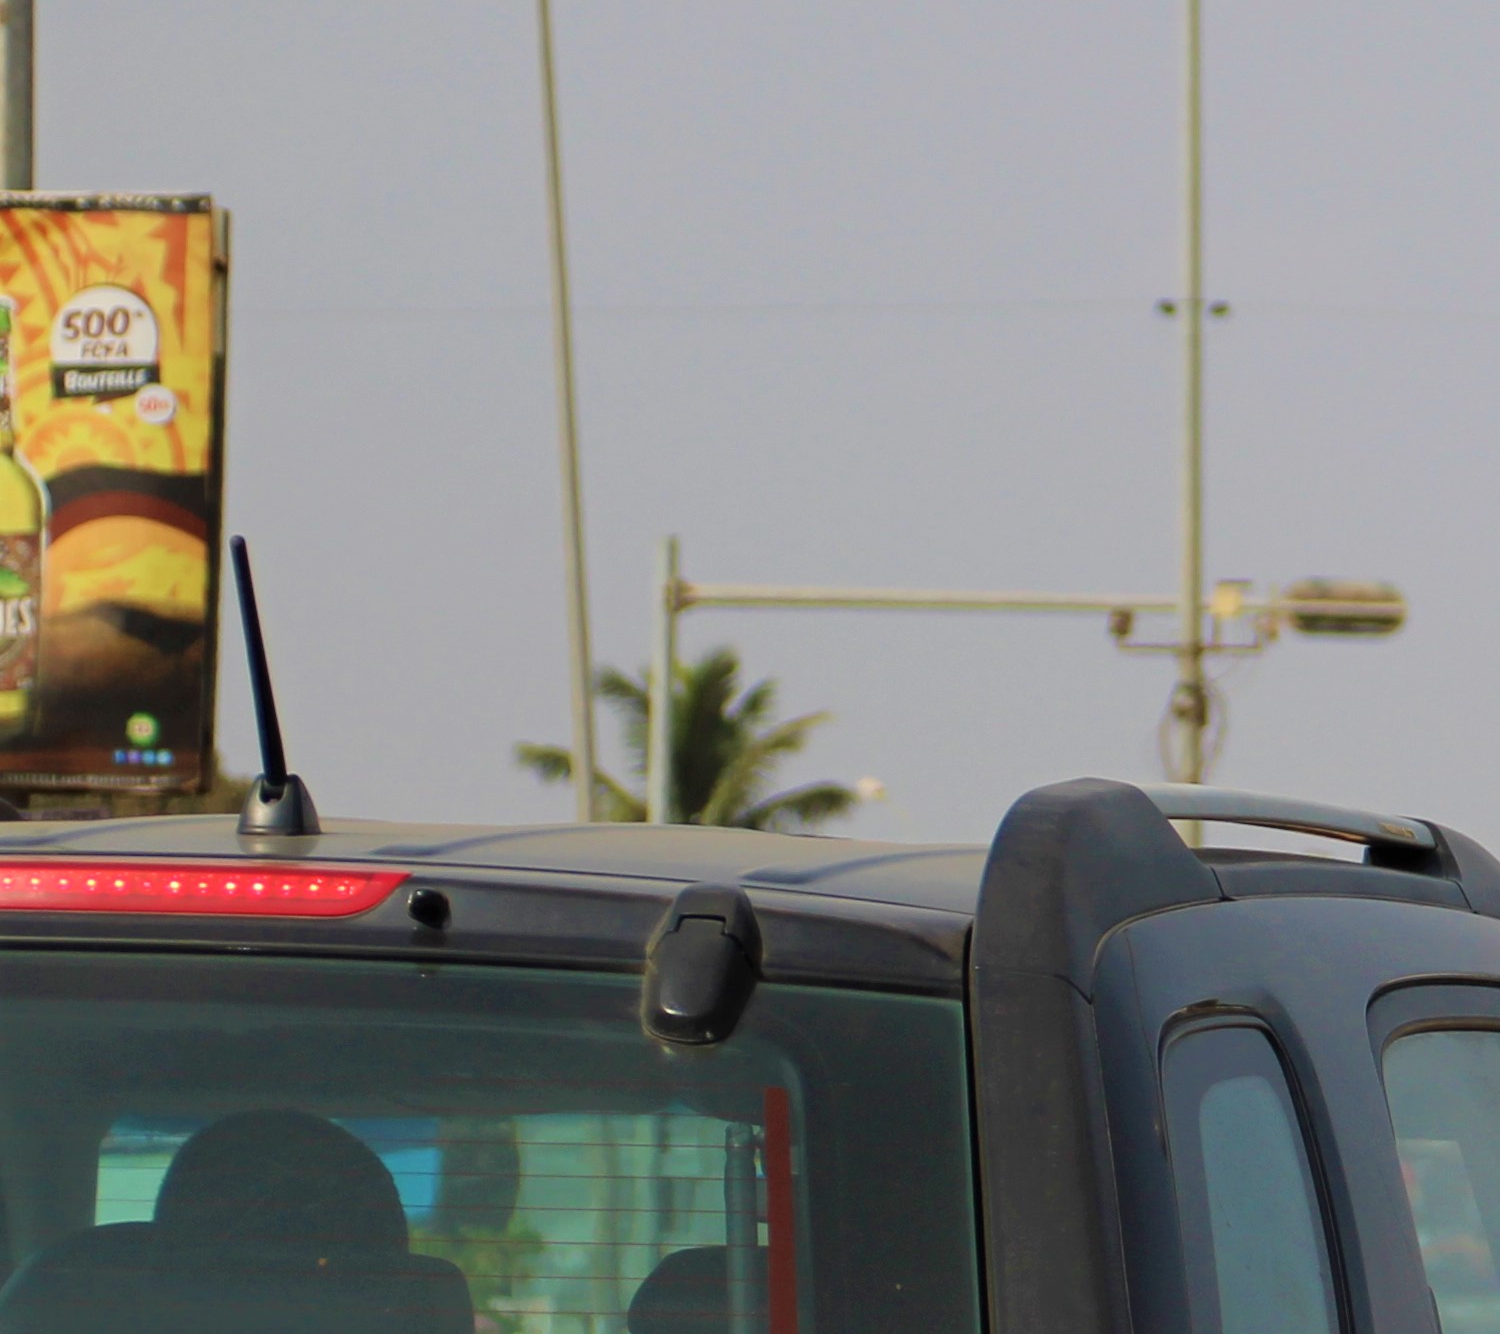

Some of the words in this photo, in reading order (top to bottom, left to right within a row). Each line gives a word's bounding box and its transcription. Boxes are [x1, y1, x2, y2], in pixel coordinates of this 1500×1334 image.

[62, 306, 130, 342] 500
[81, 340, 128, 358] FCFA
[64, 369, 147, 393] BOUTEILLE
